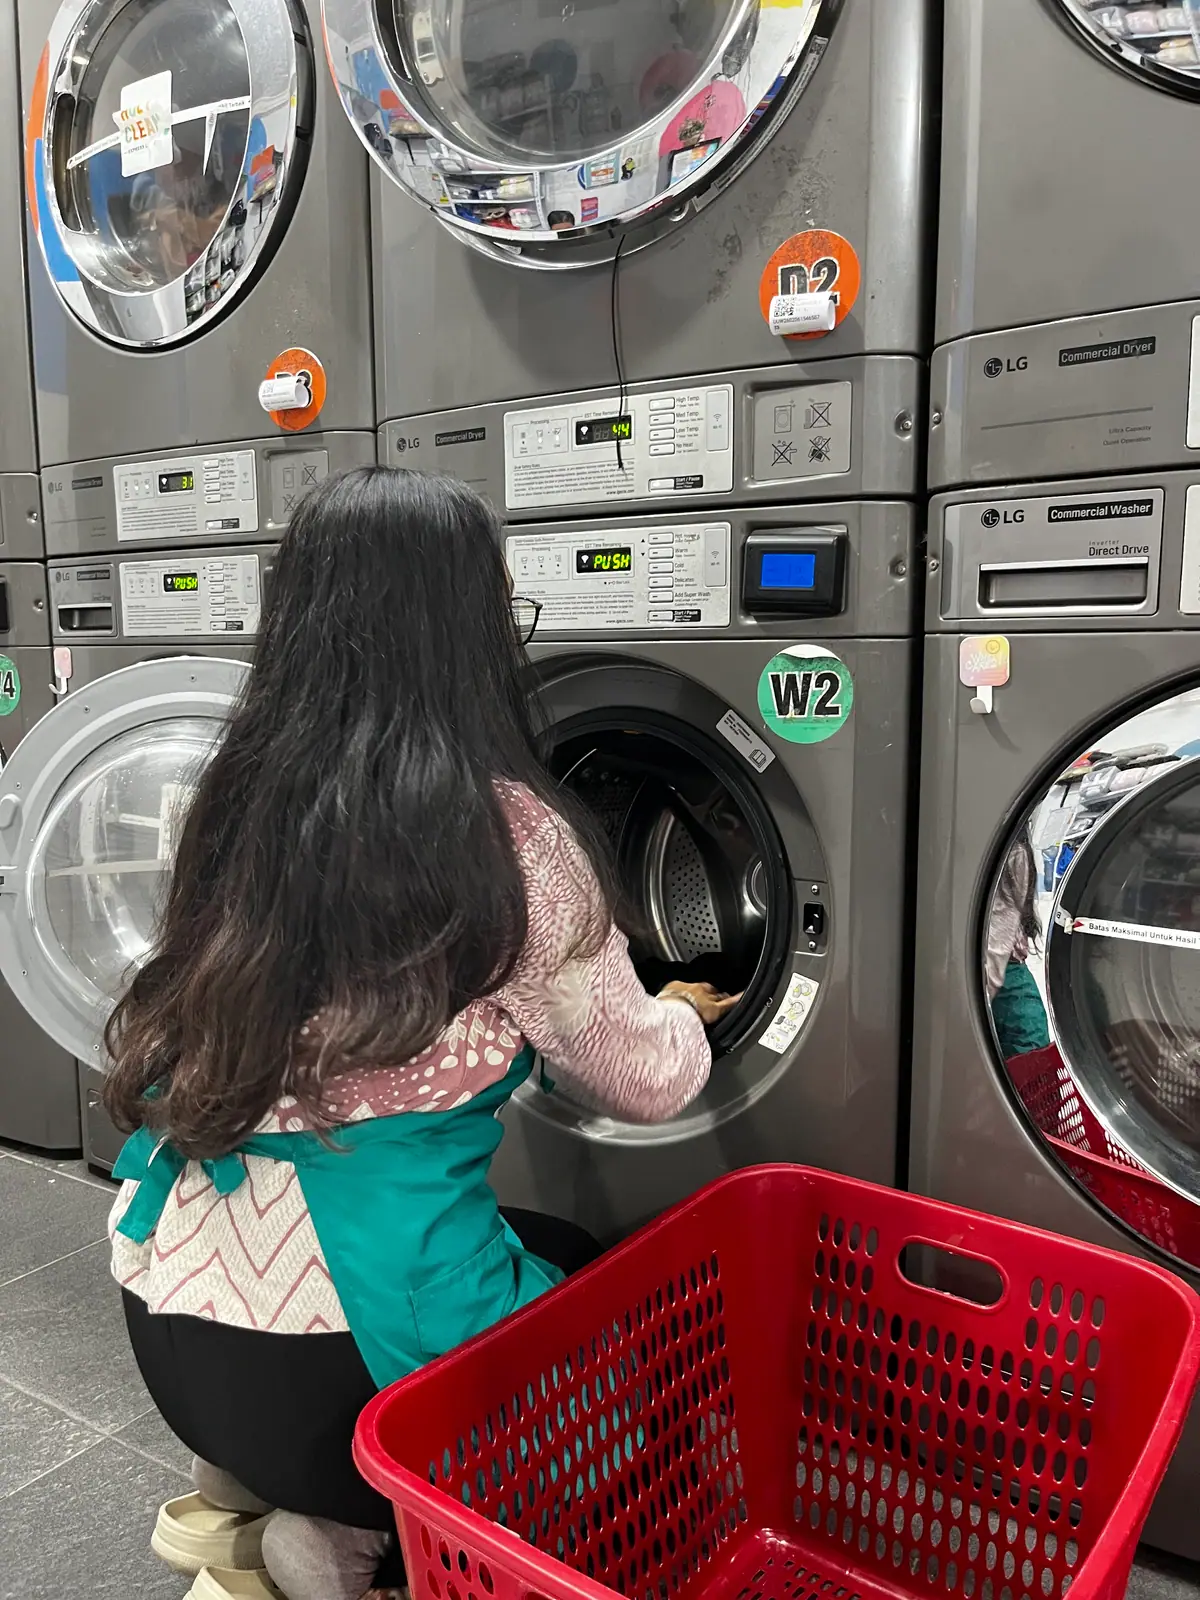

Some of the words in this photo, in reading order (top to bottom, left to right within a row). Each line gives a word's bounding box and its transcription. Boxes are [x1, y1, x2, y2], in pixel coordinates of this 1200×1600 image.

[1060, 345, 1121, 363] Commercial
[1123, 341, 1153, 356] Dryer
[1007, 356, 1028, 373] LG
[408, 437, 420, 449] LG
[437, 432, 468, 444] Commercial
[468, 431, 484, 441] Dryer
[182, 476, 193, 489] 31
[1004, 509, 1025, 524] LG
[1050, 503, 1108, 520] Commercial
[1110, 503, 1151, 516] Washer
[1089, 545, 1119, 557] Direct
[1122, 544, 1149, 555] Drive
[594, 553, 631, 570] PUSH
[63, 572, 70, 581] LG
[174, 577, 198, 590] PUSH
[0, 669, 16, 700] 4
[769, 670, 842, 719] W2
[1088, 922, 1110, 932] Batas
[1111, 924, 1148, 938] Maksimal
[1149, 931, 1173, 941] Untuk
[1175, 935, 1197, 944] Hasil
